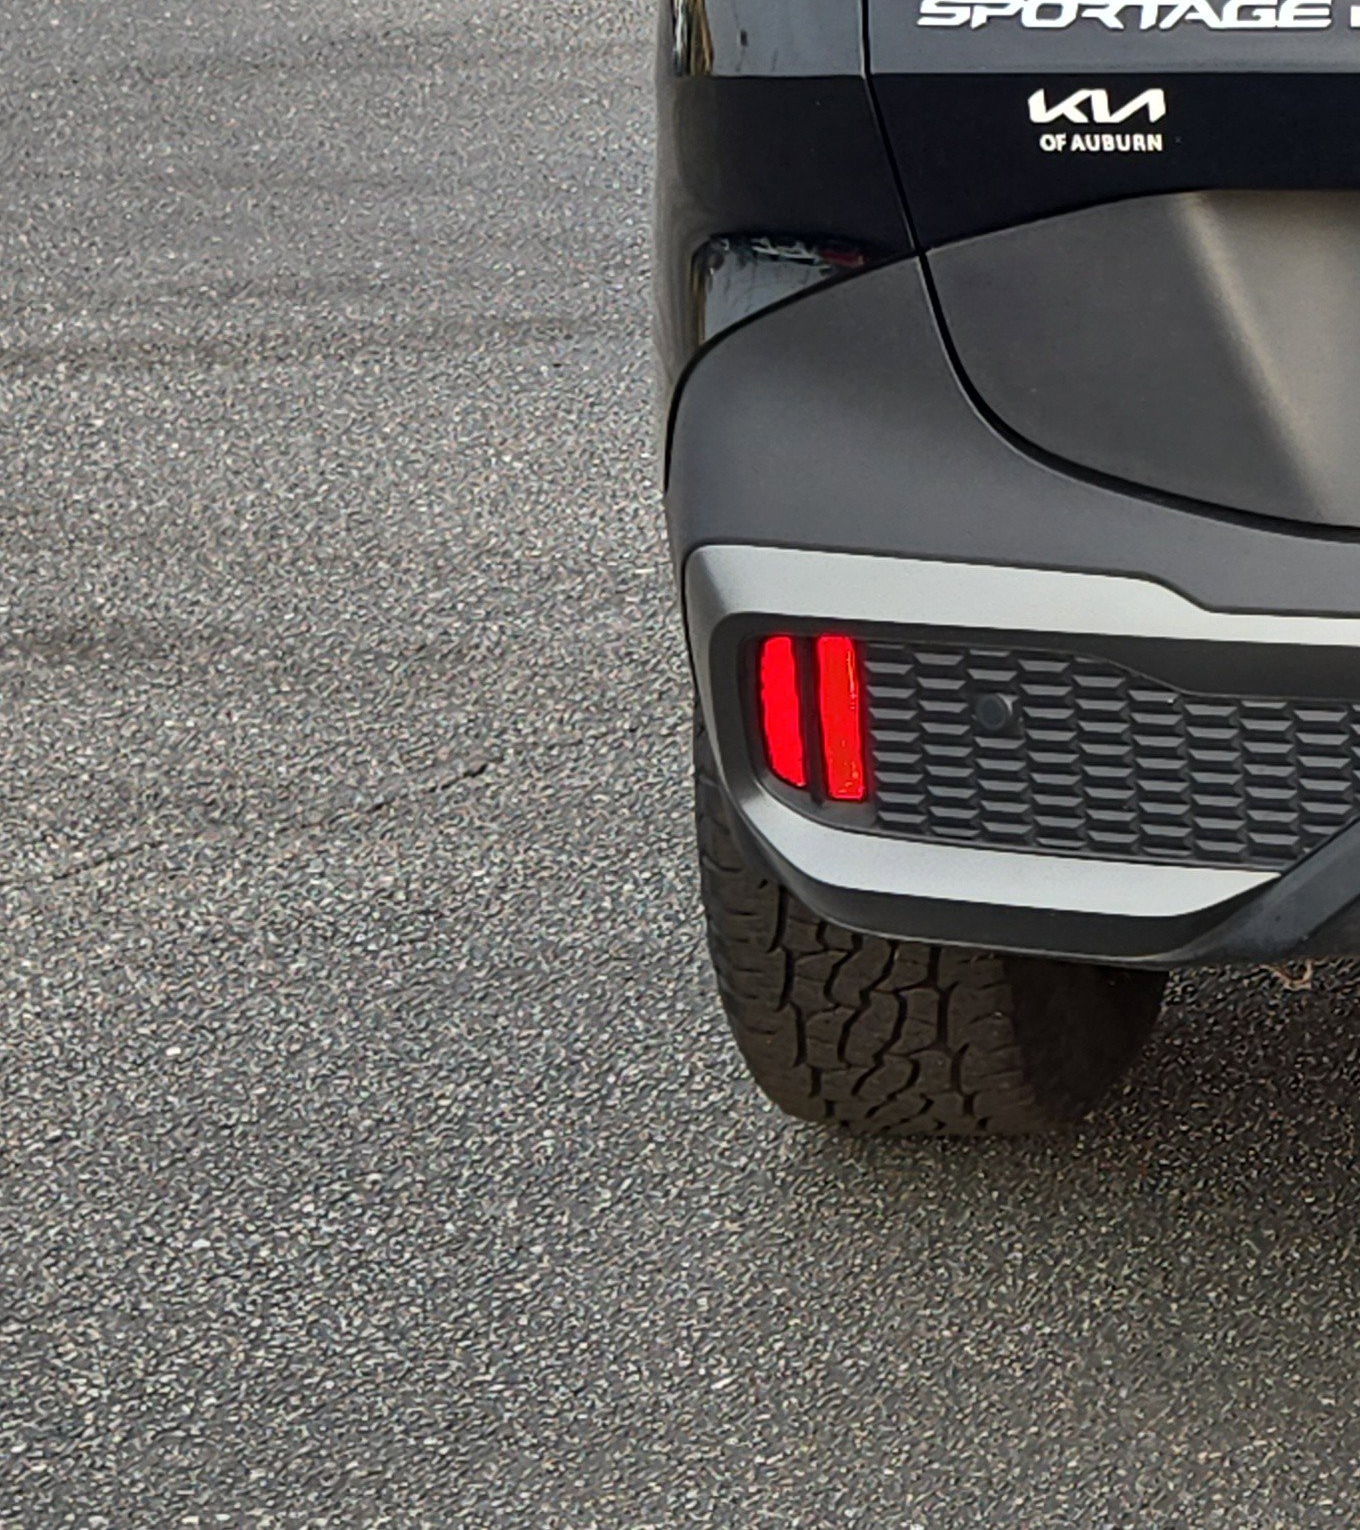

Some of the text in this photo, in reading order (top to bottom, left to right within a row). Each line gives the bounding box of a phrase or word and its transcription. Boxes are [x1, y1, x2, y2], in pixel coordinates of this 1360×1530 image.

[1027, 88, 1166, 123] KIA
[1039, 133, 1163, 152] OF AUBURN
